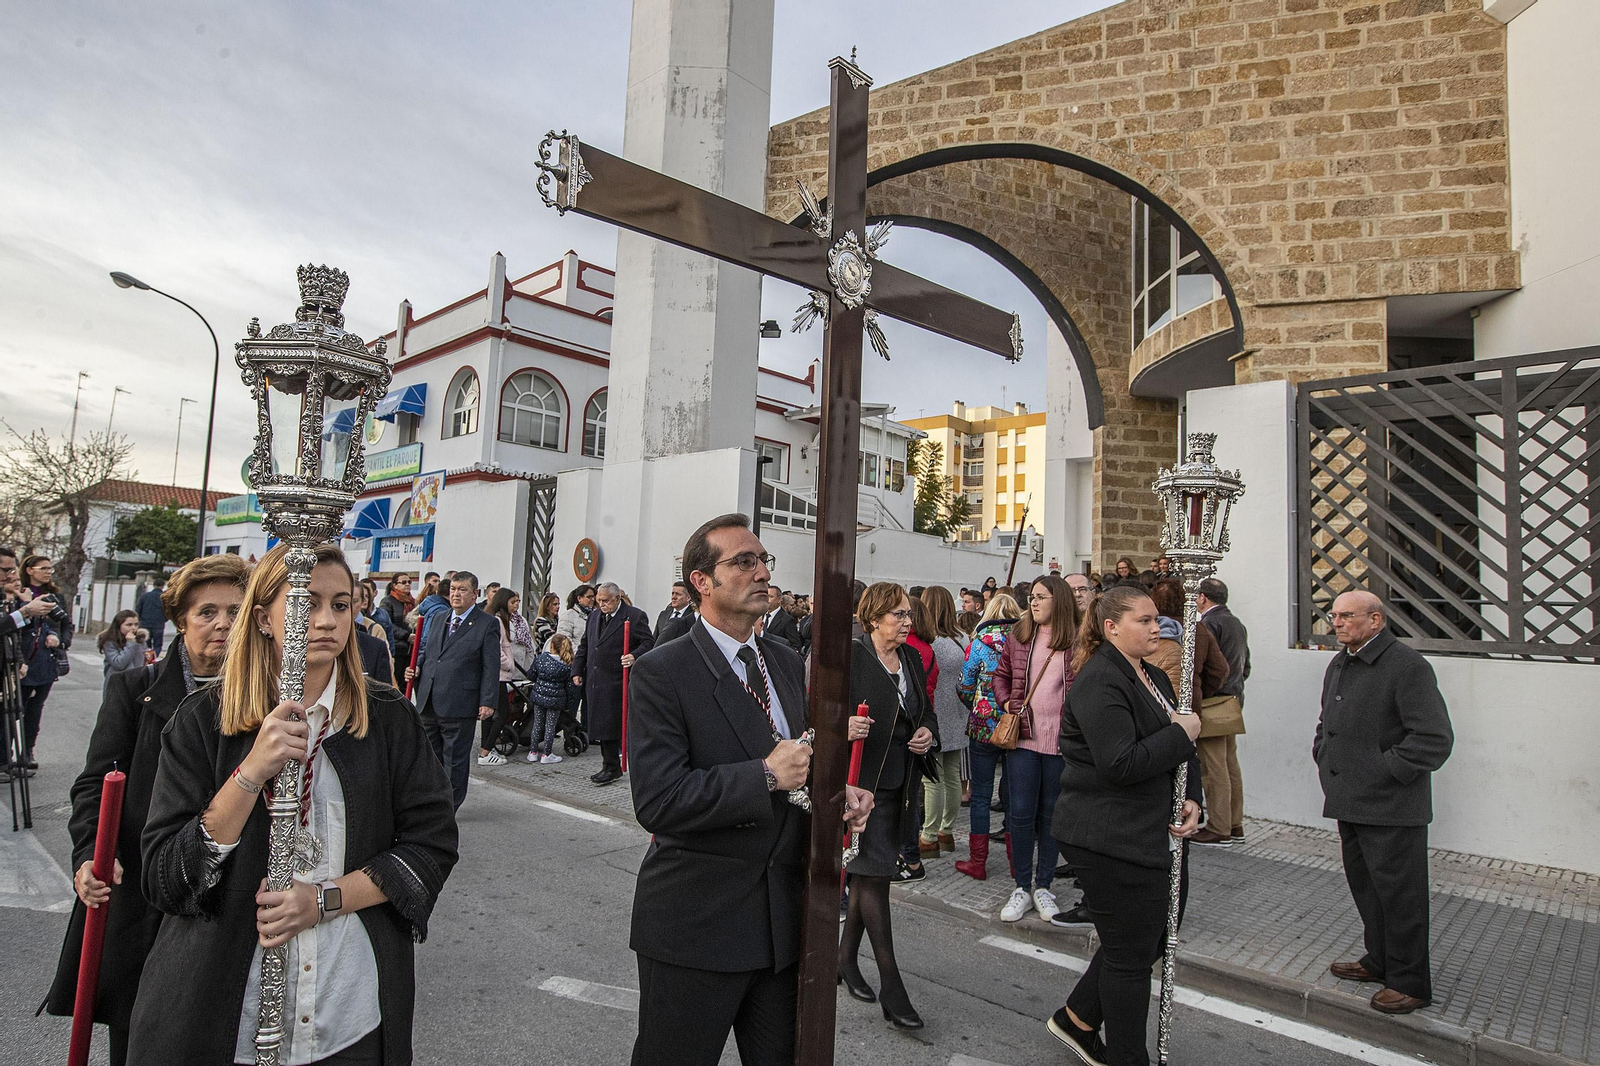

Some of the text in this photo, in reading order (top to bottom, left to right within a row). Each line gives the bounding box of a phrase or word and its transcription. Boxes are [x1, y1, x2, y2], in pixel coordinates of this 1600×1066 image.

[386, 455, 393, 468] EL
[394, 450, 418, 467] PARQUE
[381, 538, 400, 549] ESCUELA
[381, 550, 401, 560] INFANTIL
